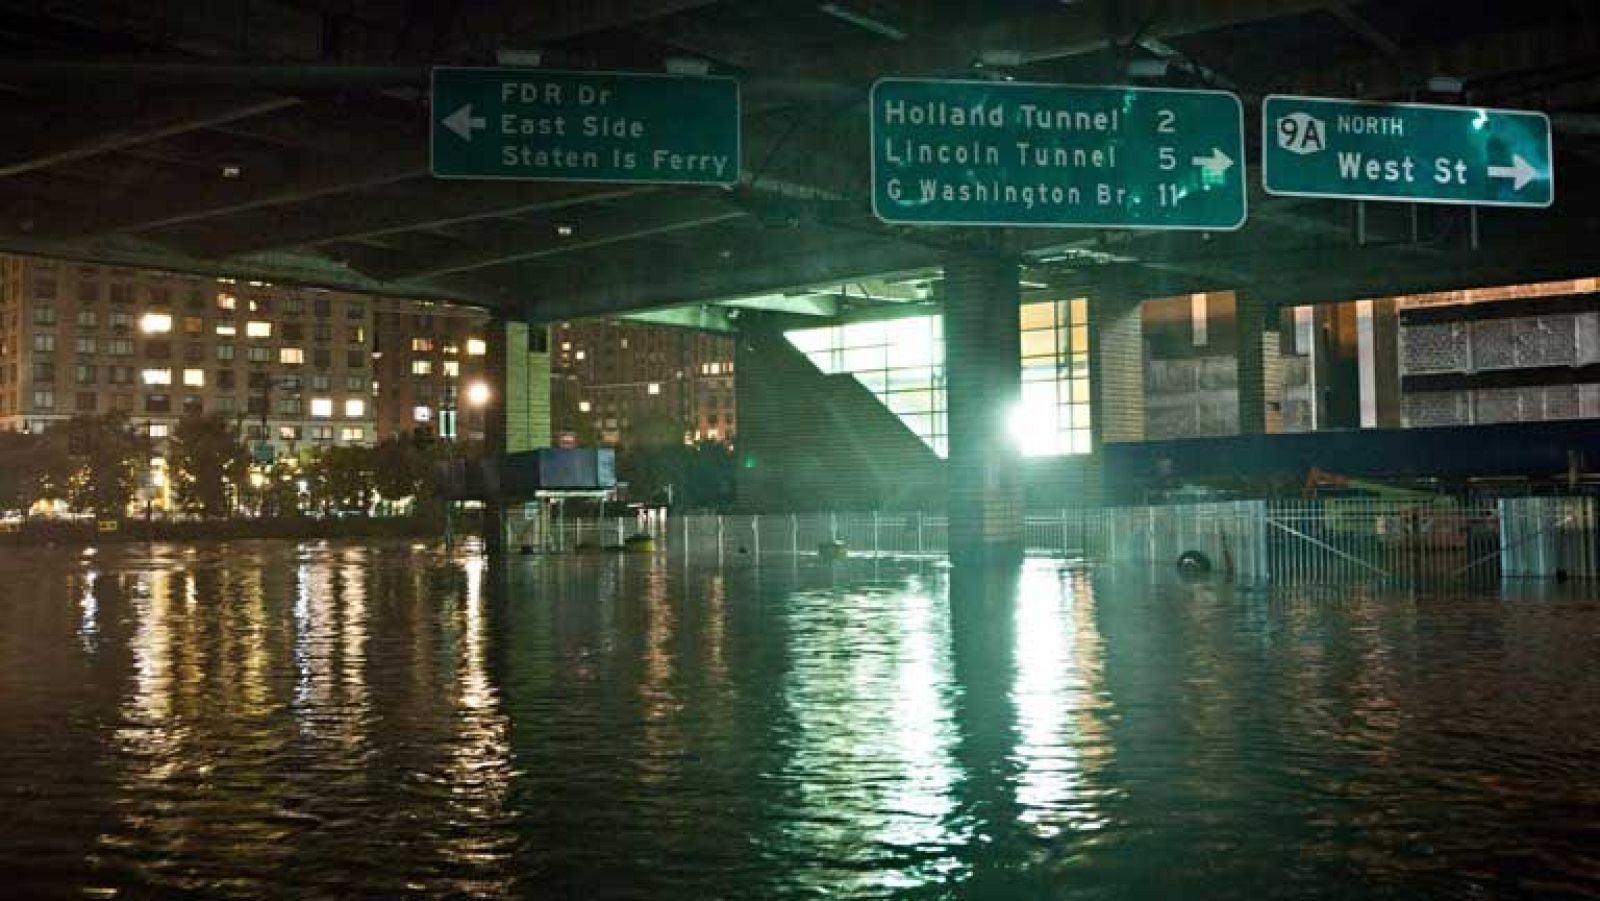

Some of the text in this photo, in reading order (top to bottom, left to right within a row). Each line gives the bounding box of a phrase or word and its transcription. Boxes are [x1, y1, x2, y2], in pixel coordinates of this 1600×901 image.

[501, 83, 612, 106] FDR Dr
[501, 114, 645, 138] East Side
[885, 99, 1176, 133] Holland Tunnel 2
[1337, 115, 1403, 136] NORTH
[1280, 118, 1322, 149] 9A
[501, 146, 728, 176] Staten Is Ferry
[885, 139, 1176, 170] Lincoln Tunnel 5
[1337, 151, 1467, 185] West St
[887, 180, 902, 201] G
[919, 178, 1080, 209] Washington
[1157, 184, 1179, 207] 11
